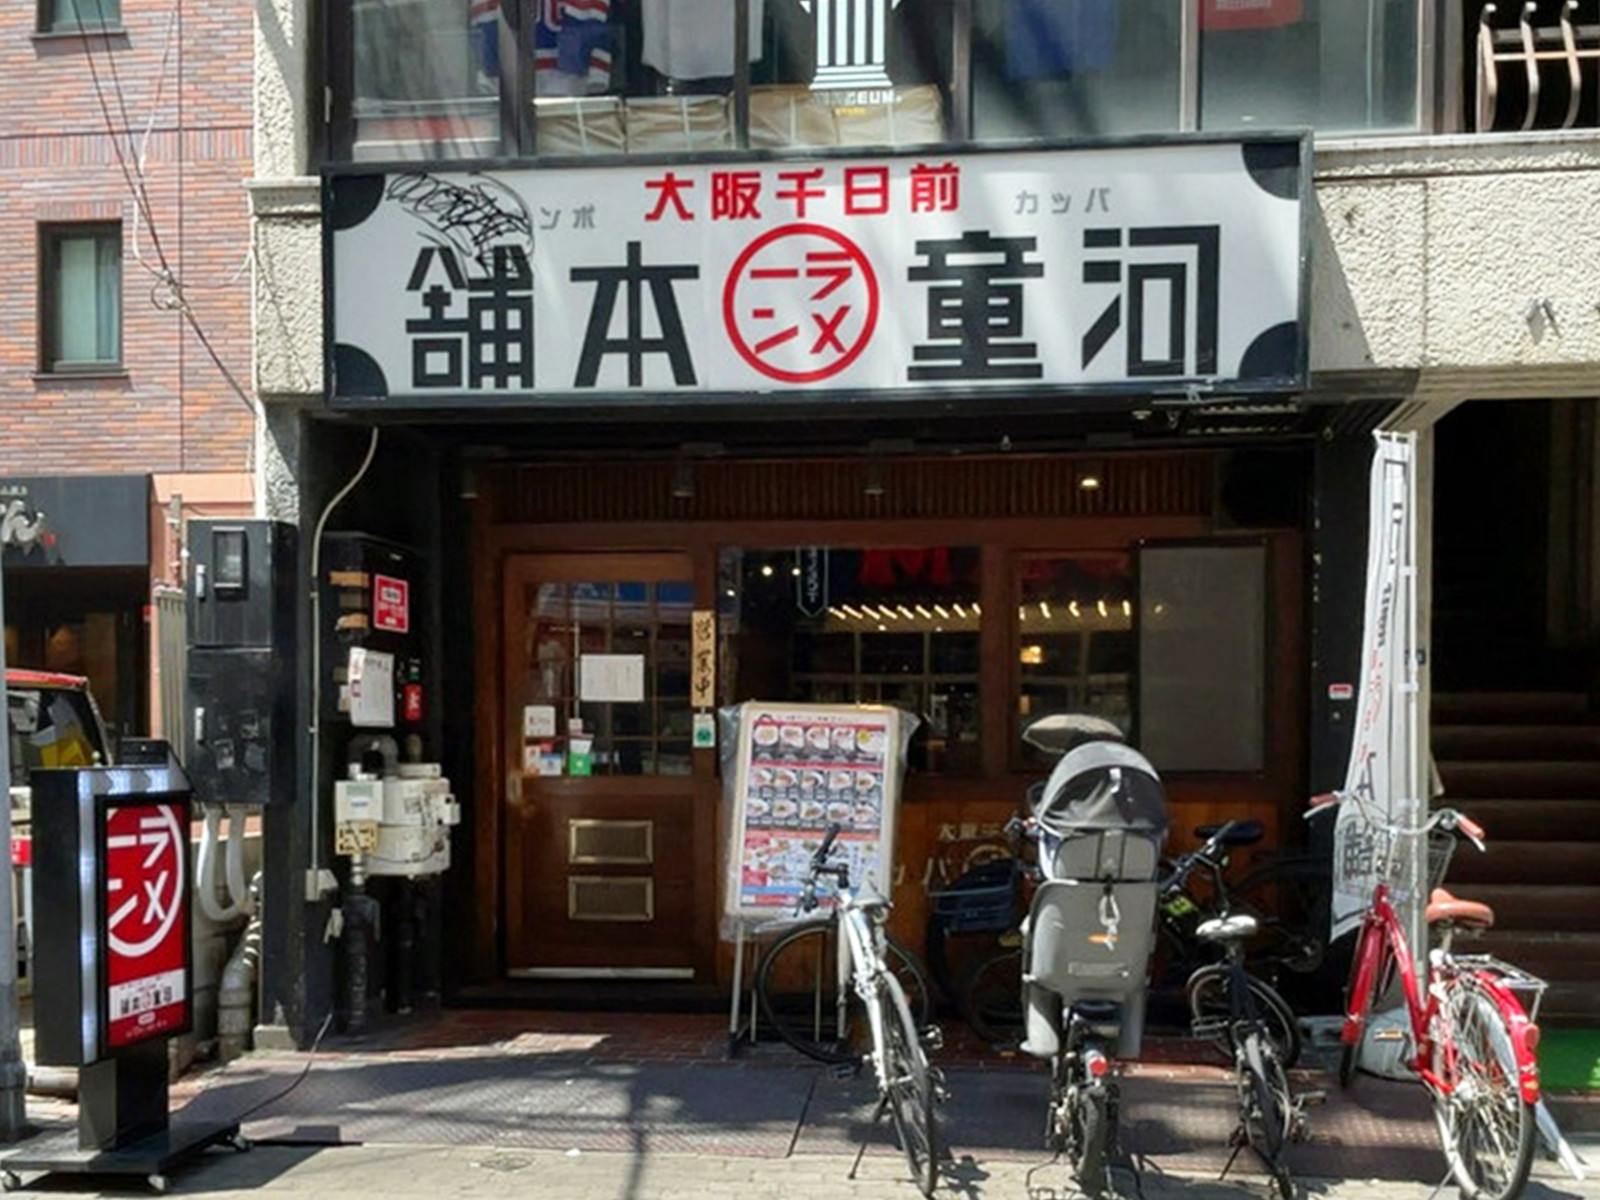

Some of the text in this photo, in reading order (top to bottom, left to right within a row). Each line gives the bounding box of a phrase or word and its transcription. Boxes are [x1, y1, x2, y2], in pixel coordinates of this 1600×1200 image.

[645, 163, 960, 221] 大阪千日前
